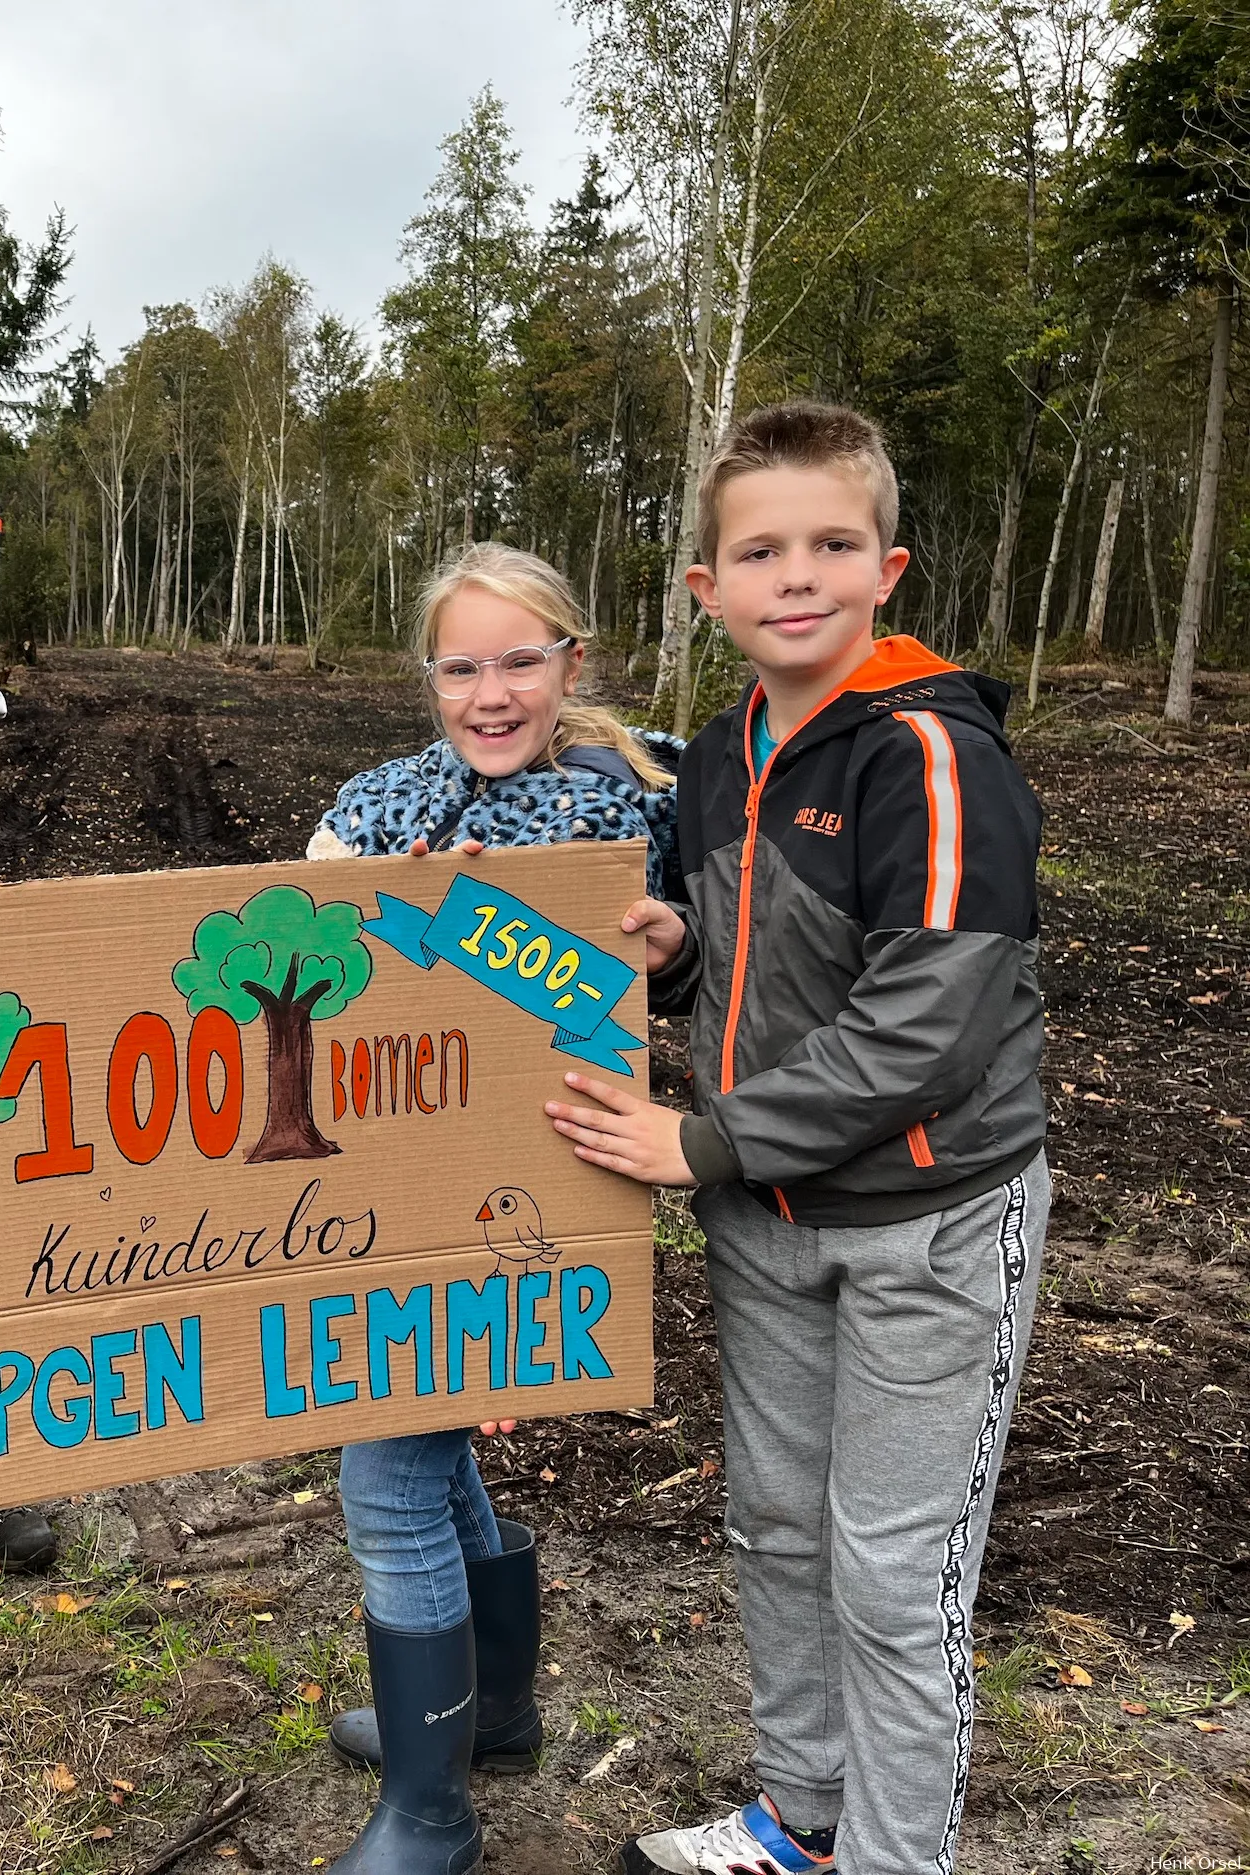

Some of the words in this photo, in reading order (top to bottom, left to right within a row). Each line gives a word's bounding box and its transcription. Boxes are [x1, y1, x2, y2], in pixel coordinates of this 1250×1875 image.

[817, 811, 843, 832] JEA
[458, 904, 603, 1010] 1500,-
[26, 1178, 377, 1298] Kuinderbos
[1003, 1209, 1022, 1264] MOVING
[261, 1264, 614, 1420] LEMMER
[943, 1588, 963, 1624] KEEP
[946, 1625, 964, 1676] MVING
[439, 1687, 474, 1719] DUNLO
